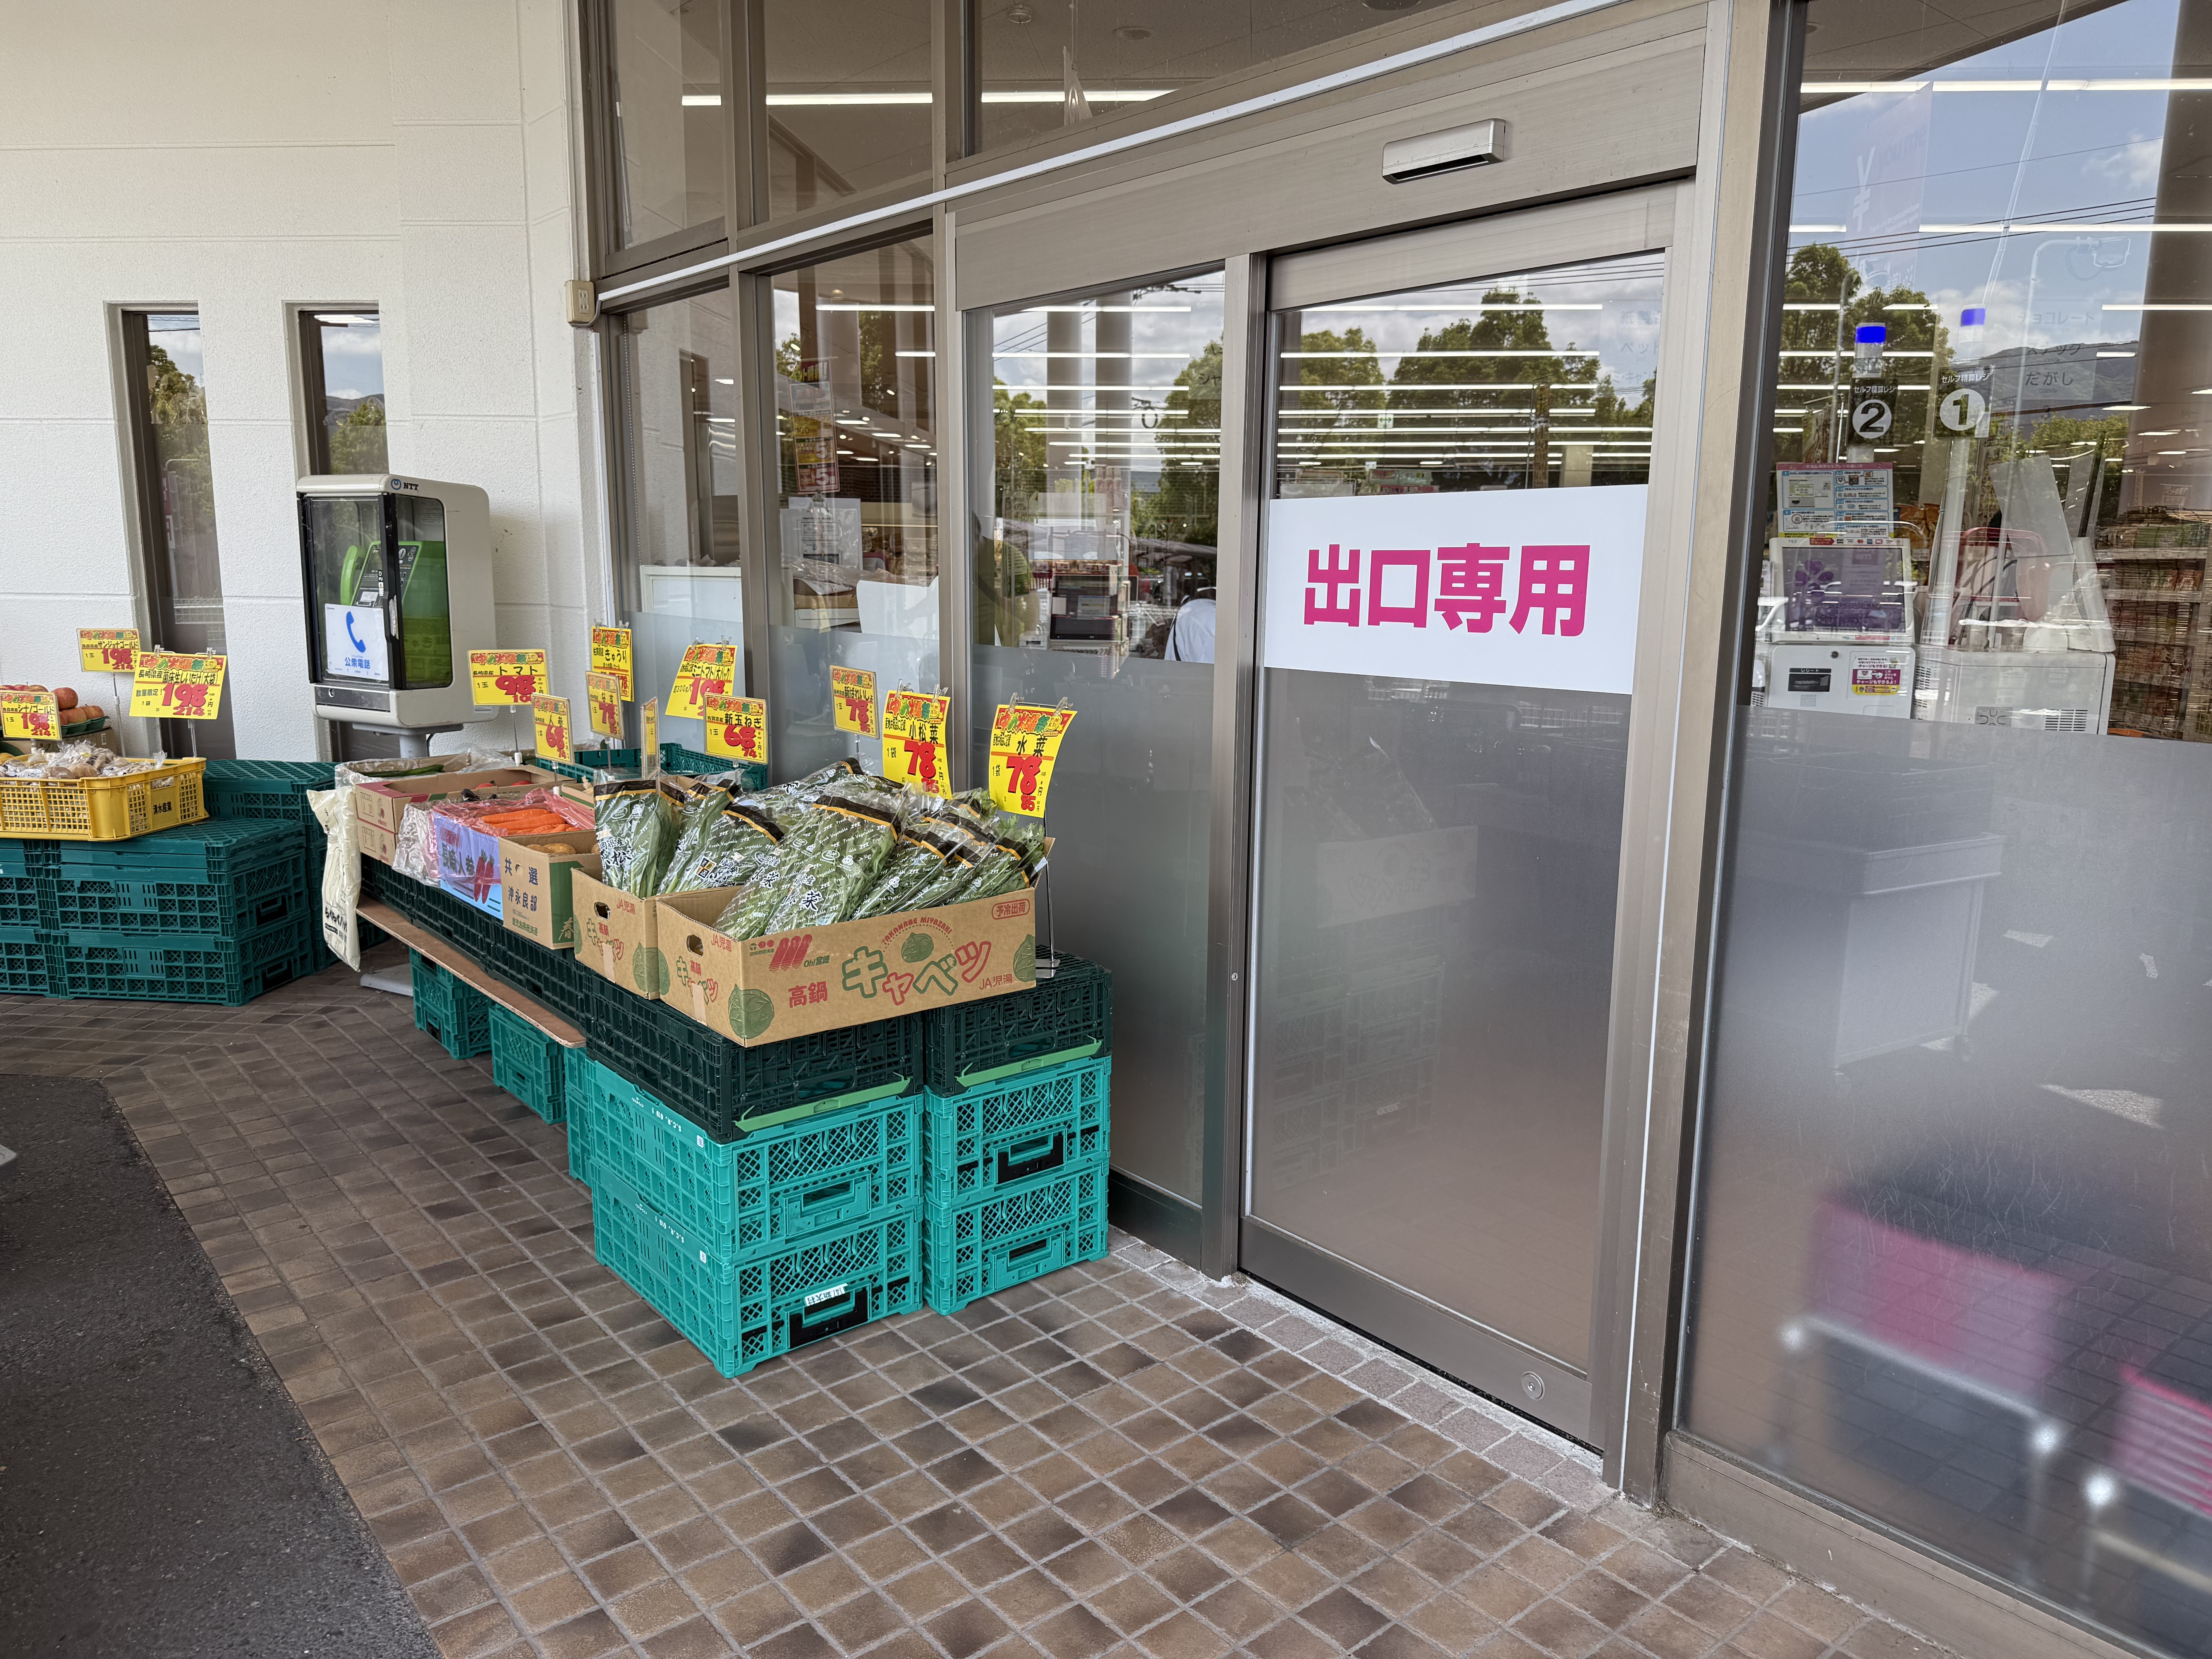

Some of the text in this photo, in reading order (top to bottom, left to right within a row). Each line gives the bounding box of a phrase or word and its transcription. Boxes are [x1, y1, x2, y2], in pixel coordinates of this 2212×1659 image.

[1199, 373, 1221, 386] シャ
[1941, 374, 1990, 383] セルフ精算レジ
[2025, 372, 2073, 386] だがし
[1854, 385, 1897, 394] セルフ精算レジ
[1859, 402, 1885, 433] 2
[1953, 394, 1969, 426] 1
[403, 482, 419, 491] NTT
[1304, 543, 1590, 636] 出口専用
[101, 649, 132, 664] 198
[345, 657, 370, 669] 公衆電話
[605, 650, 627, 663] きゅうり
[139, 670, 218, 685] 長崎県産 菌床生しいたけ(大袋)
[500, 666, 538, 675] トマト
[136, 689, 163, 697] 数量限定!
[495, 675, 536, 695] 98
[162, 684, 209, 707] 198
[173, 706, 205, 716] 214
[599, 702, 616, 726] 78
[846, 699, 869, 723] 78
[21, 713, 50, 730] 198
[725, 713, 762, 729] 新玉ねぎ
[860, 723, 871, 733] 85
[546, 725, 565, 750] 68
[724, 725, 756, 749] 68
[909, 721, 938, 744] 小松菜
[742, 748, 757, 758] 74
[887, 747, 896, 758] 1袋
[1017, 735, 1048, 756] 水菜
[557, 749, 567, 759] 74
[904, 740, 936, 778] 78
[993, 764, 1000, 776] 1袋
[1006, 756, 1042, 795] 78
[1038, 787, 1043, 796] 円
[1021, 795, 1036, 811] 85
[819, 828, 848, 845] Fresh Vegetable
[855, 828, 874, 839] Vegetable
[505, 857, 538, 885] 共選
[508, 886, 537, 912] 沖永良部
[617, 898, 635, 914] JA児湯
[795, 909, 826, 924] Fresh Vegetable
[996, 901, 1026, 917] 予冷出荷
[598, 922, 609, 937] 高鍋
[881, 917, 952, 945] TAKANABE MIYAZAKI
[711, 934, 732, 952] JA児湯
[690, 960, 701, 976] 高鍋
[804, 955, 830, 967] Oh!宮崎
[842, 941, 992, 1006] キャベツ
[979, 974, 1013, 990] JA児湯
[788, 981, 828, 1008] 高鍋
[665, 1116, 682, 1132] S.C.R.
[668, 1226, 684, 1243] S.C.R.
